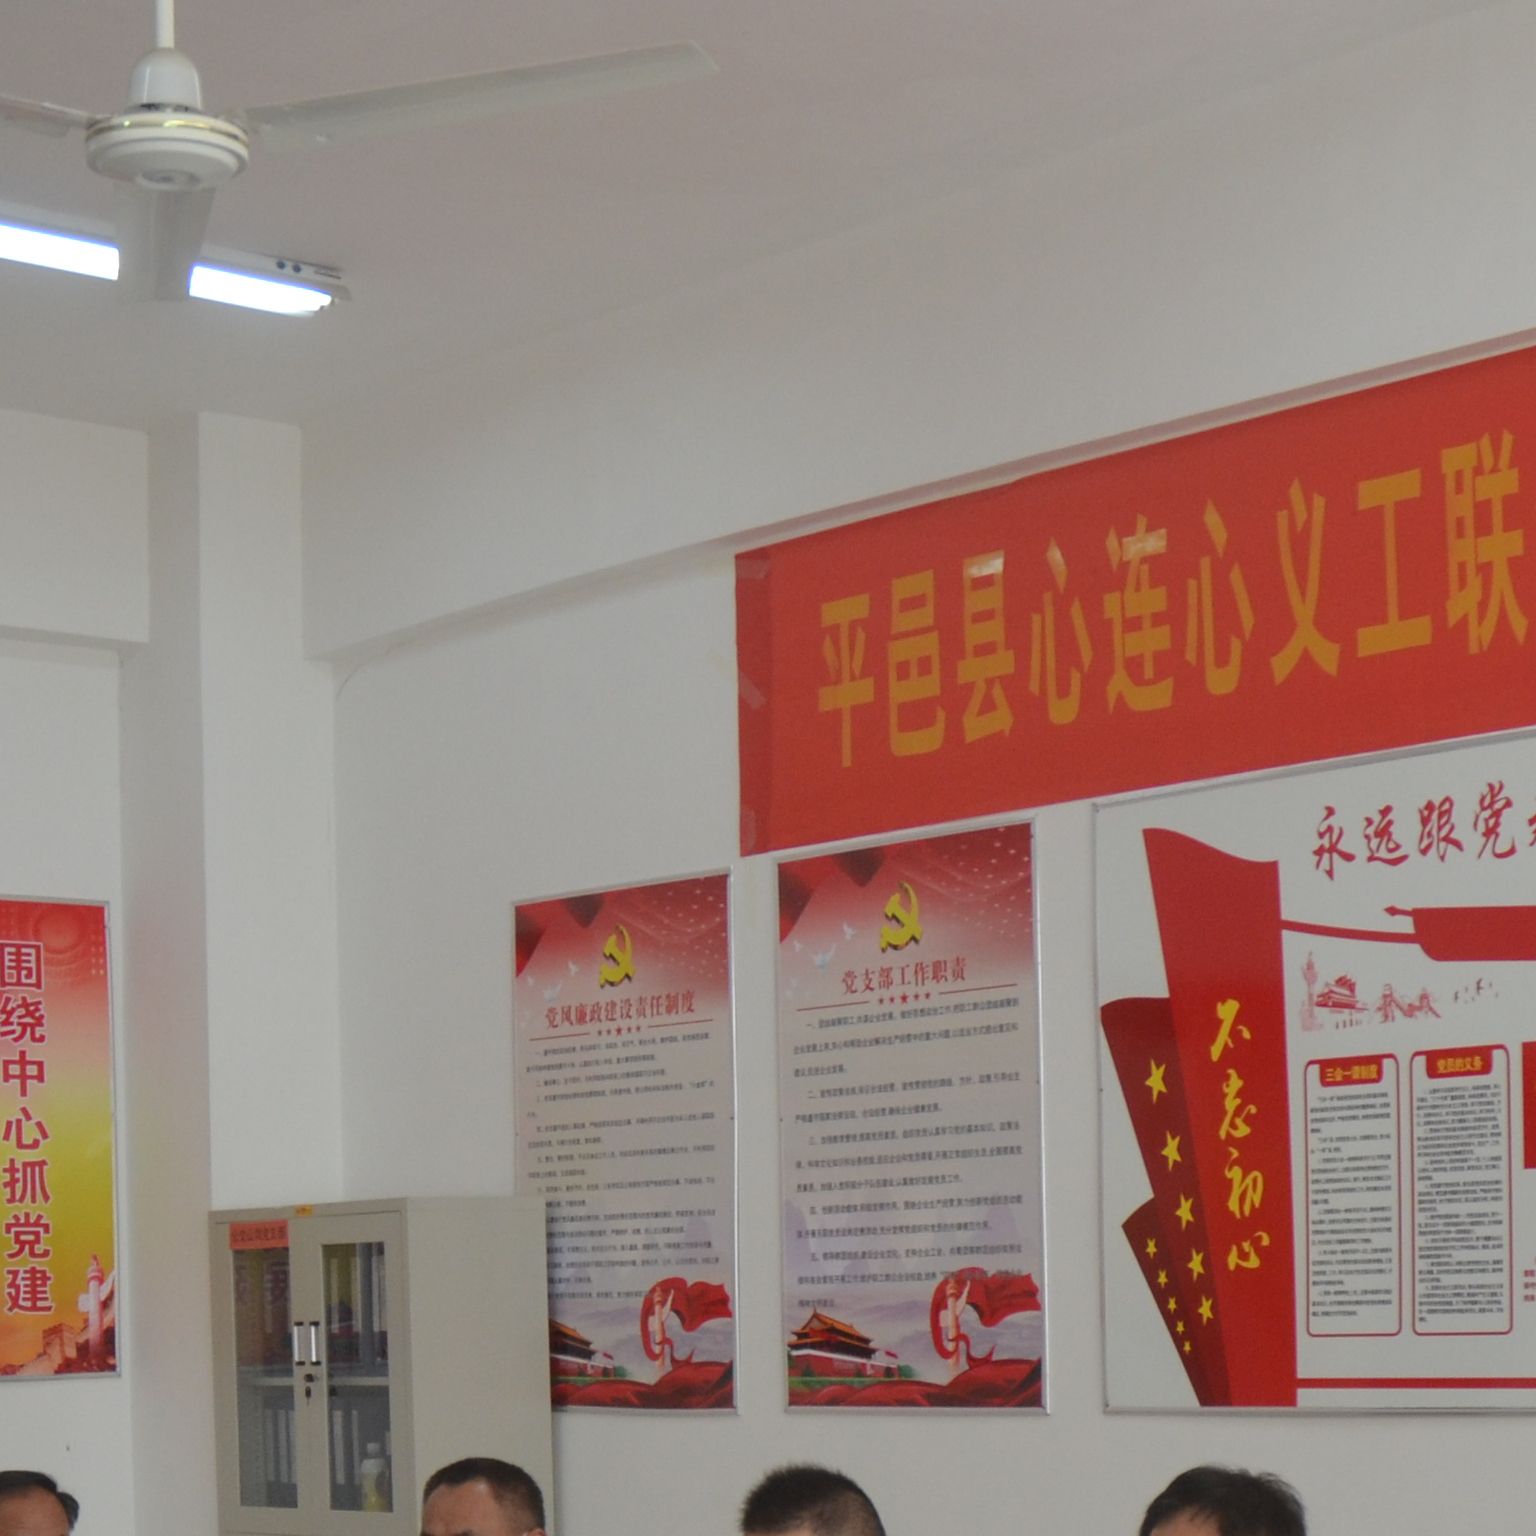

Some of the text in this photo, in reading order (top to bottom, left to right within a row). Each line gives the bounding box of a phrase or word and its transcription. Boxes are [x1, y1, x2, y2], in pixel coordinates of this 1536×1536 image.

[841, 955, 967, 996] 党支部工作职责
[544, 989, 696, 1030] 党风廉政建设责任制度
[1436, 1055, 1484, 1075] 党员的义务
[1208, 997, 1272, 1274] 不忘初心
